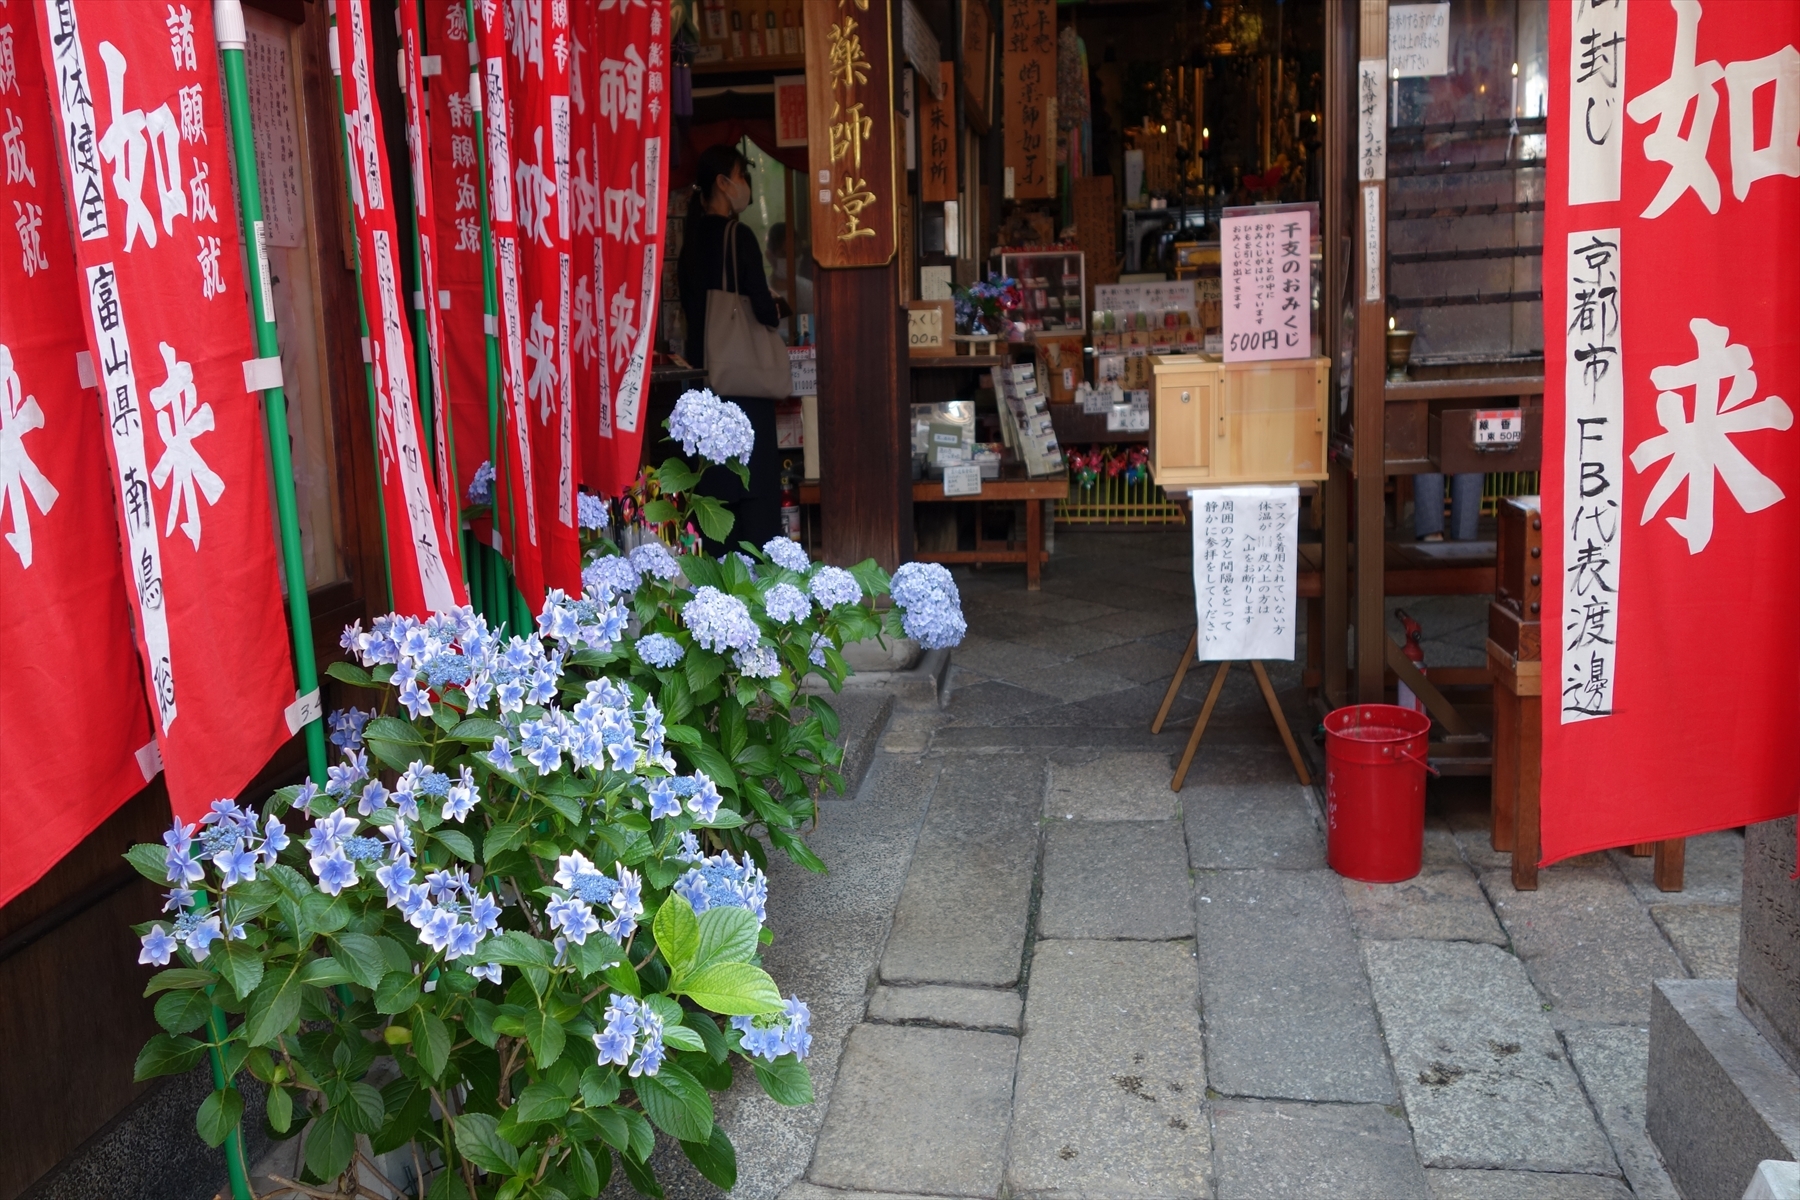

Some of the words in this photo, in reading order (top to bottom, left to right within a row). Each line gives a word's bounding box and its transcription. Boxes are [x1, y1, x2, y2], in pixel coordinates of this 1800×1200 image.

[165, 4, 227, 302] 諸願成就
[99, 39, 227, 552] 如来
[1233, 225, 1242, 310] おみくじが出てきます
[1244, 225, 1253, 275] ひもを引くと
[1255, 223, 1264, 325] おみくじがはいっています
[1265, 223, 1275, 299] かわいいえとの中に
[1626, 0, 1800, 557] 如来
[1230, 329, 1279, 352] 500円
[1500, 431, 1521, 440] 50円
[1204, 501, 1219, 642] 静かに参拝をしてください
[1220, 500, 1234, 631] 周囲の方と間隔をとって
[1241, 533, 1256, 625] 入山をお断りします
[1273, 502, 1287, 636] マスクを着用されていない方
